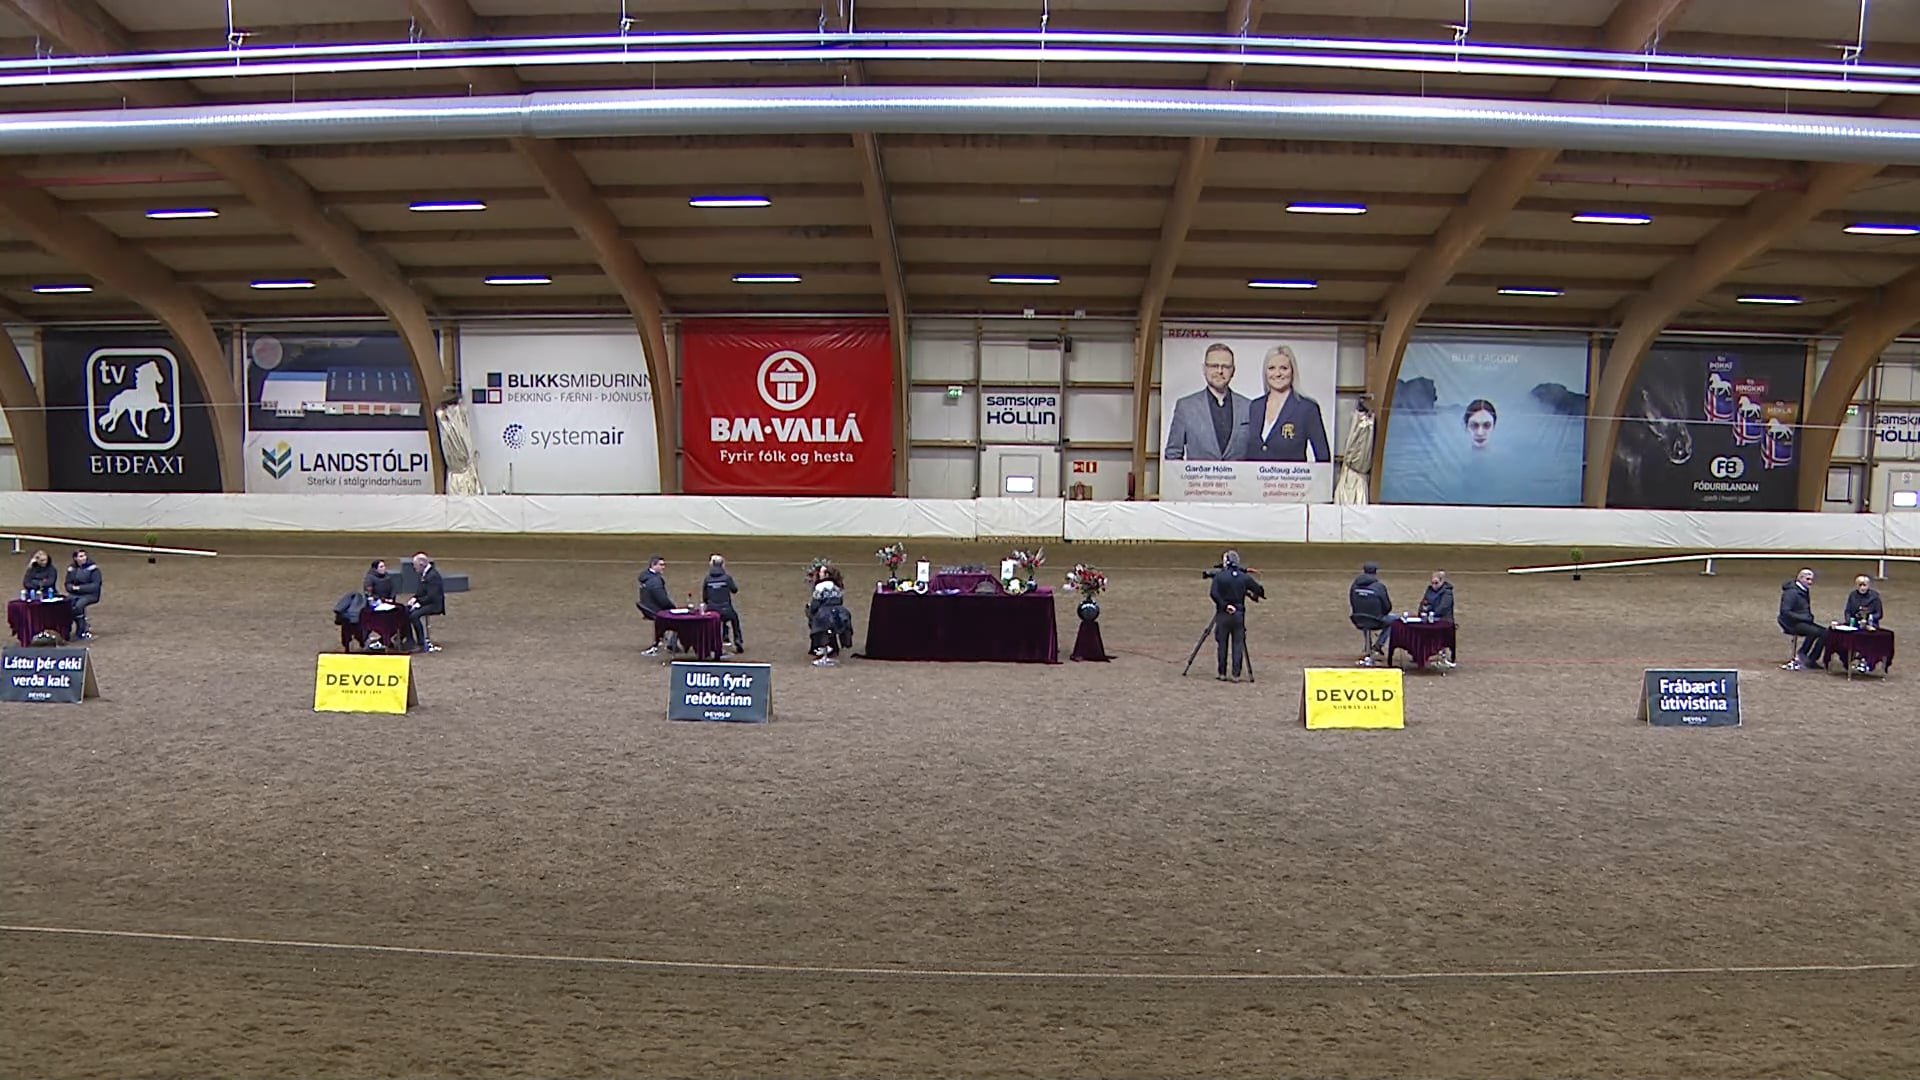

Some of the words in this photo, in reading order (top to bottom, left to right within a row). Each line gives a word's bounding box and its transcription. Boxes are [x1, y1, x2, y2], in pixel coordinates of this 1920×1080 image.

[1168, 329, 1209, 338] RE/MAX
[99, 360, 126, 384] tv
[508, 392, 551, 402] ÞEKKING
[560, 392, 592, 402] FÆRNI
[987, 407, 1056, 424] HÖLLIN
[530, 426, 624, 450] systemair
[300, 448, 428, 472] LANDSTÓLPI
[719, 449, 754, 464] Fyrir
[758, 450, 786, 463] fólk
[790, 453, 809, 464] og
[814, 450, 854, 463] hesta
[90, 455, 184, 474] EIÐFAXI
[1717, 460, 1737, 474] FB
[307, 477, 337, 487] Sterkir
[4, 656, 34, 669] Láttu
[36, 656, 56, 672] þér
[58, 657, 82, 670] ekki
[12, 674, 45, 686] verða
[47, 674, 70, 687] kalt
[326, 673, 399, 687] DEVOLD
[686, 672, 720, 687] Ullin
[723, 673, 753, 691] fyrir
[1660, 678, 1718, 694] Frábært
[685, 692, 752, 706] reiðtúrinn
[1316, 689, 1394, 702] DEVOLD
[1660, 695, 1728, 711] útivistina
